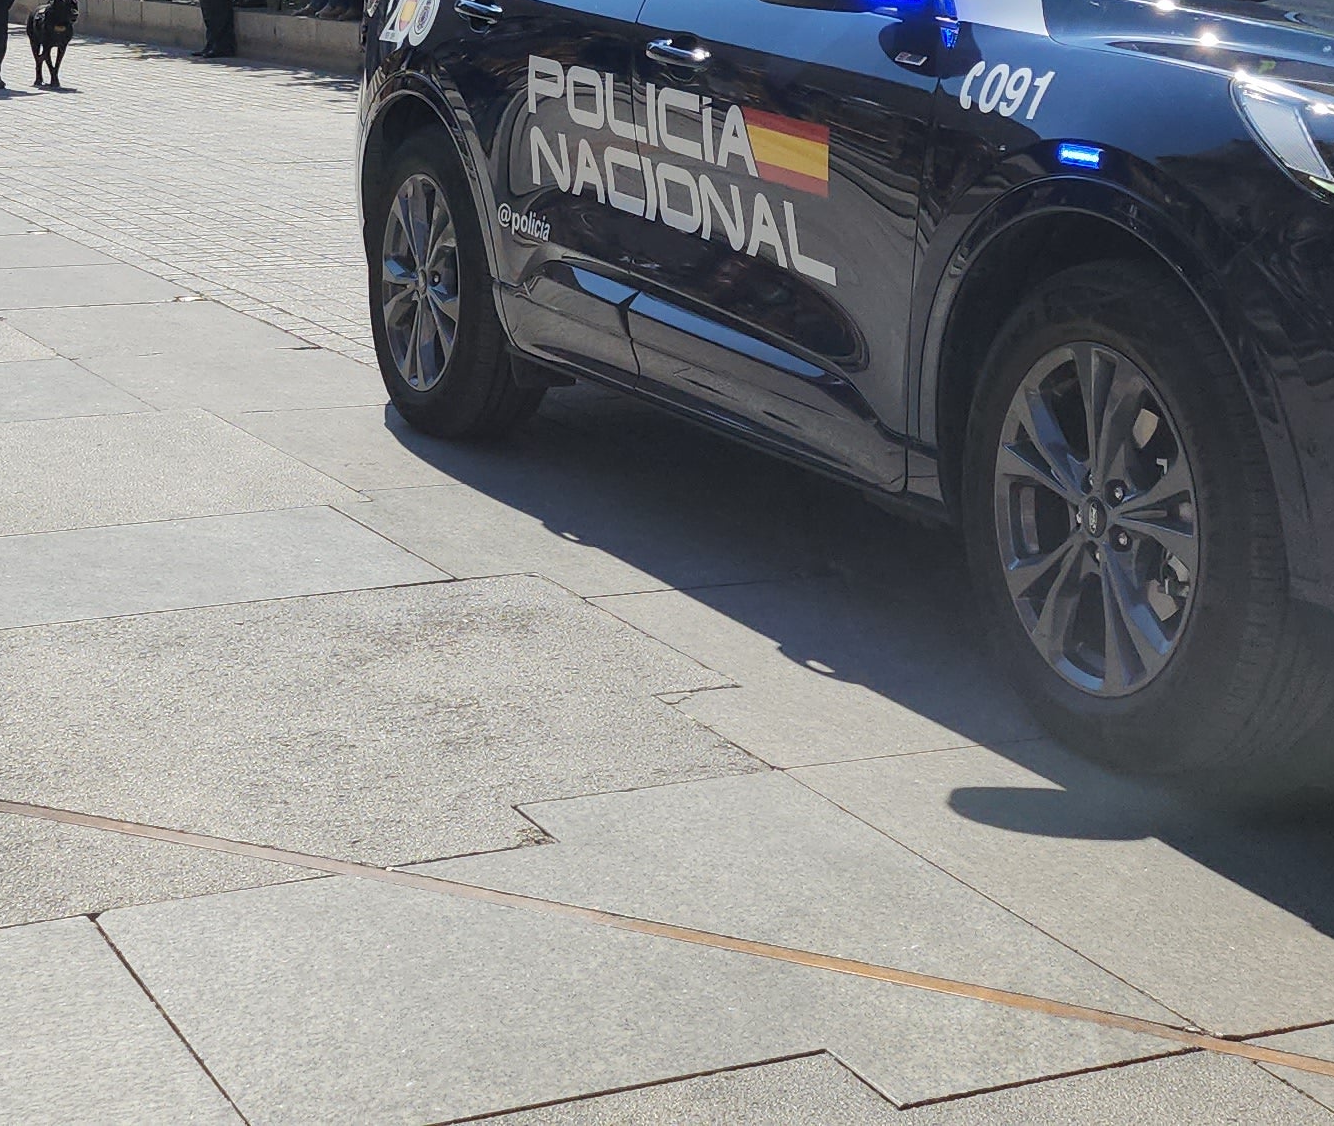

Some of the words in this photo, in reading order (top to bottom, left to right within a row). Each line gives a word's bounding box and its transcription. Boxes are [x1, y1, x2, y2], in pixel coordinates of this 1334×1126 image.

[979, 63, 1056, 120] 091
[497, 202, 551, 242] @policia
[530, 126, 837, 286] NACIONAL
